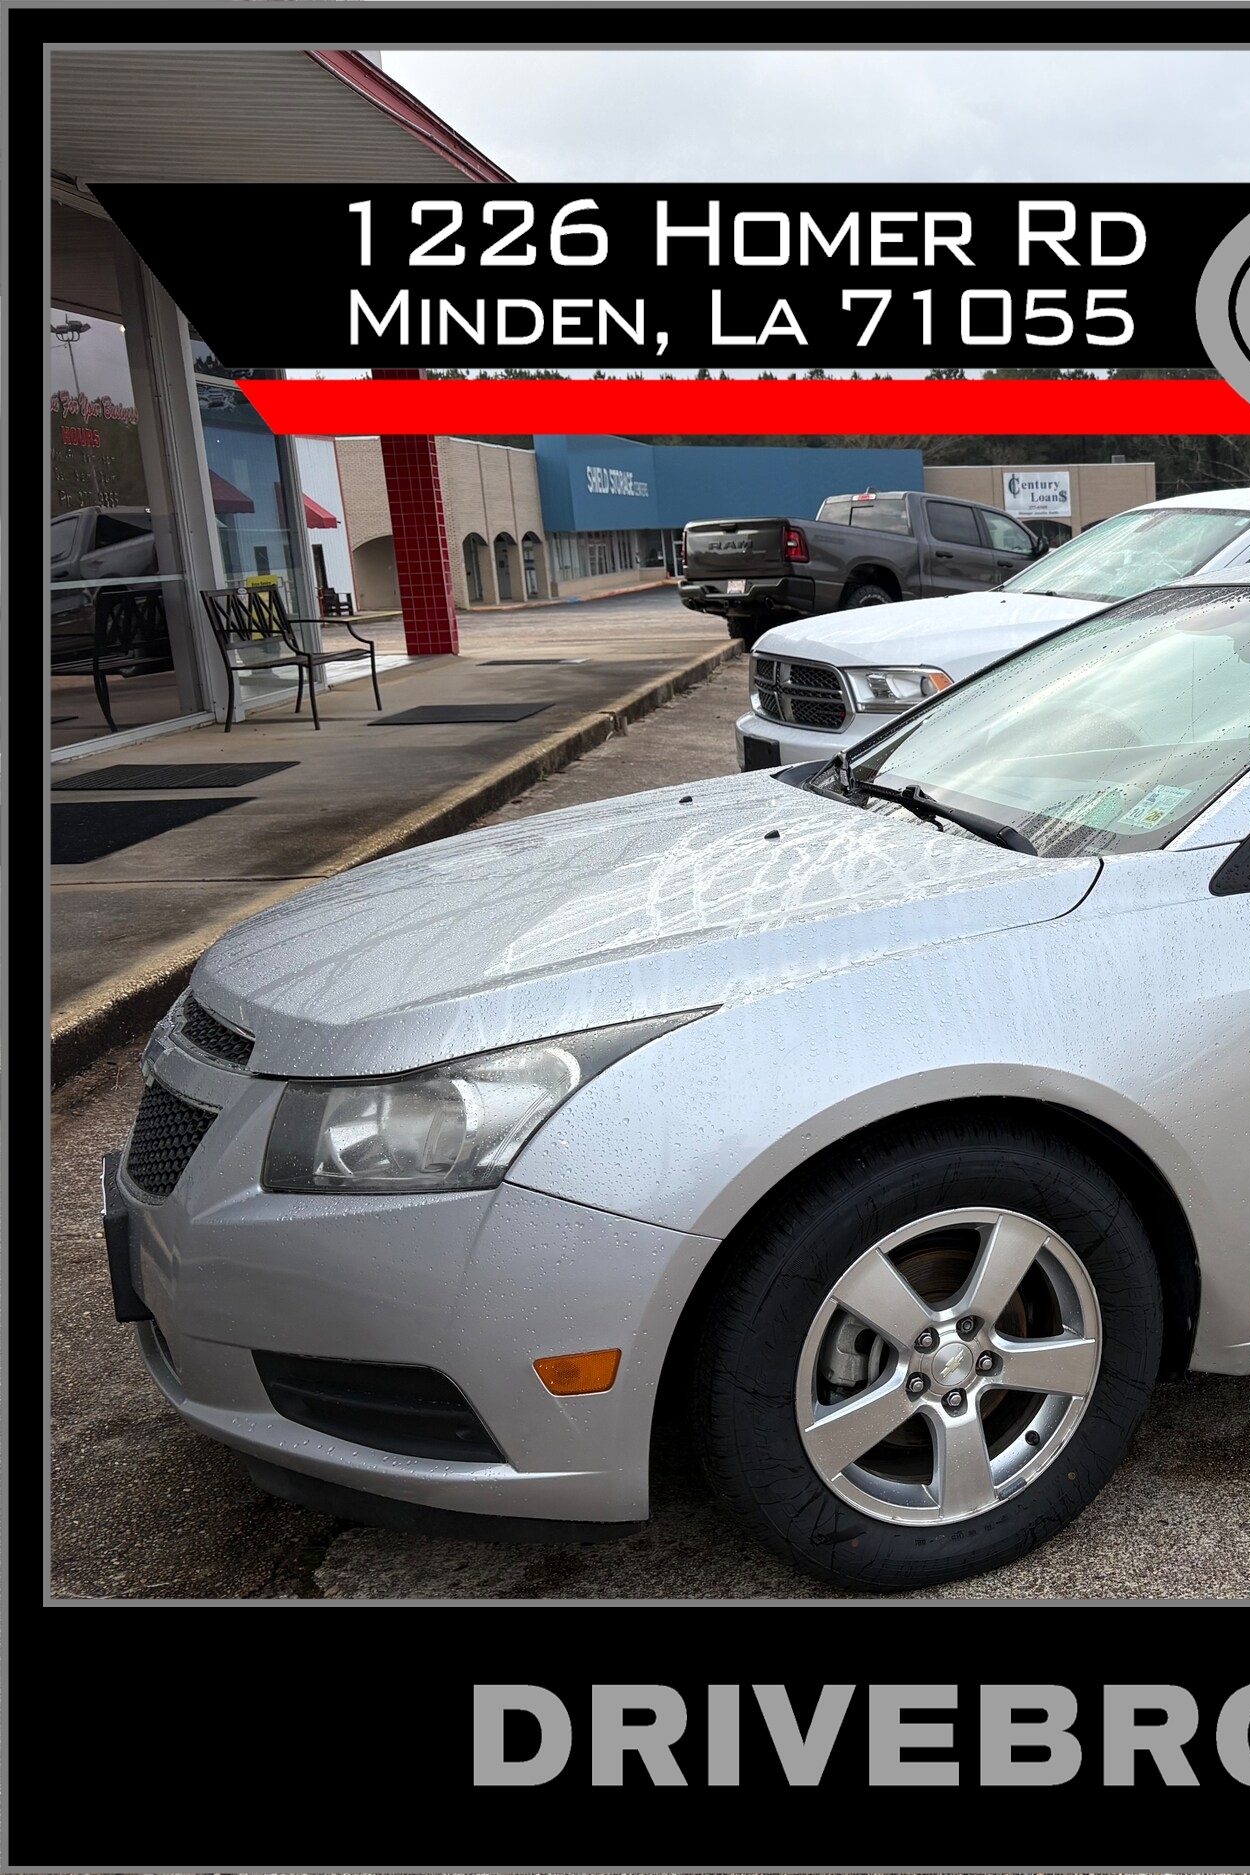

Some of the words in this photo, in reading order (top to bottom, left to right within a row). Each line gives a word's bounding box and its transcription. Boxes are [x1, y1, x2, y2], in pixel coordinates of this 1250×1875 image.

[61, 425, 101, 448] HOURS
[586, 465, 610, 494] SHIELD
[609, 468, 634, 496] STORAGE
[708, 539, 753, 551] RAM
